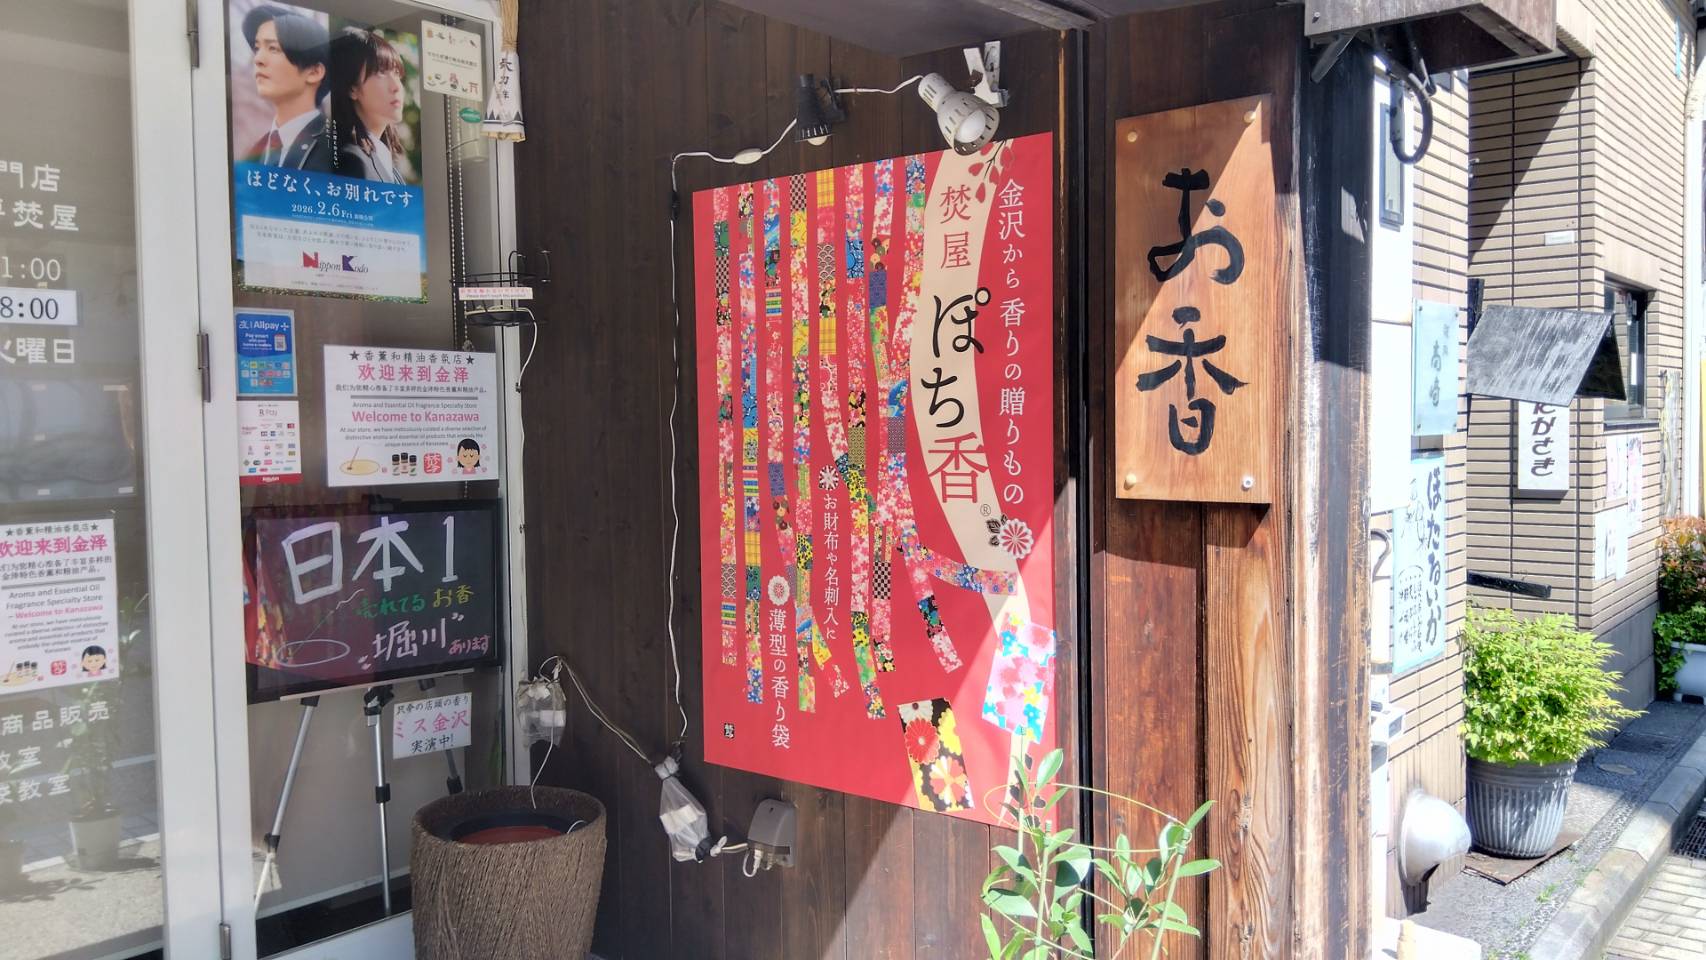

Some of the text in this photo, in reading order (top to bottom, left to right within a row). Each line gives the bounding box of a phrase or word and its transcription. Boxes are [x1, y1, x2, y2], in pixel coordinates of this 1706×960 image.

[247, 170, 412, 208] ほどなく、お別れです
[0, 199, 79, 231] 焚屋
[303, 251, 368, 273] Nippon Kodo
[0, 296, 59, 320] 8:00
[1136, 167, 1250, 455] お香
[921, 185, 991, 503] 焚屋 ぽち香
[998, 179, 1026, 504] 金沢から香りの贈りもの
[358, 363, 469, 383] 欢迎来到金泽
[352, 411, 479, 422] Welcome to Kanazawa
[0, 534, 107, 557] 欢迎来到金泽
[281, 516, 458, 604] 日本1
[823, 495, 839, 640] お財布や名刺入に
[9, 590, 36, 599] Aroma
[38, 588, 53, 597] and
[54, 585, 88, 595] Essential
[16, 611, 52, 619] Welcome
[65, 604, 103, 613] Kanazawa
[768, 610, 790, 749] 薄型の香り袋
[1, 701, 109, 736] 商品販売
[395, 710, 469, 738] ミス金沢
